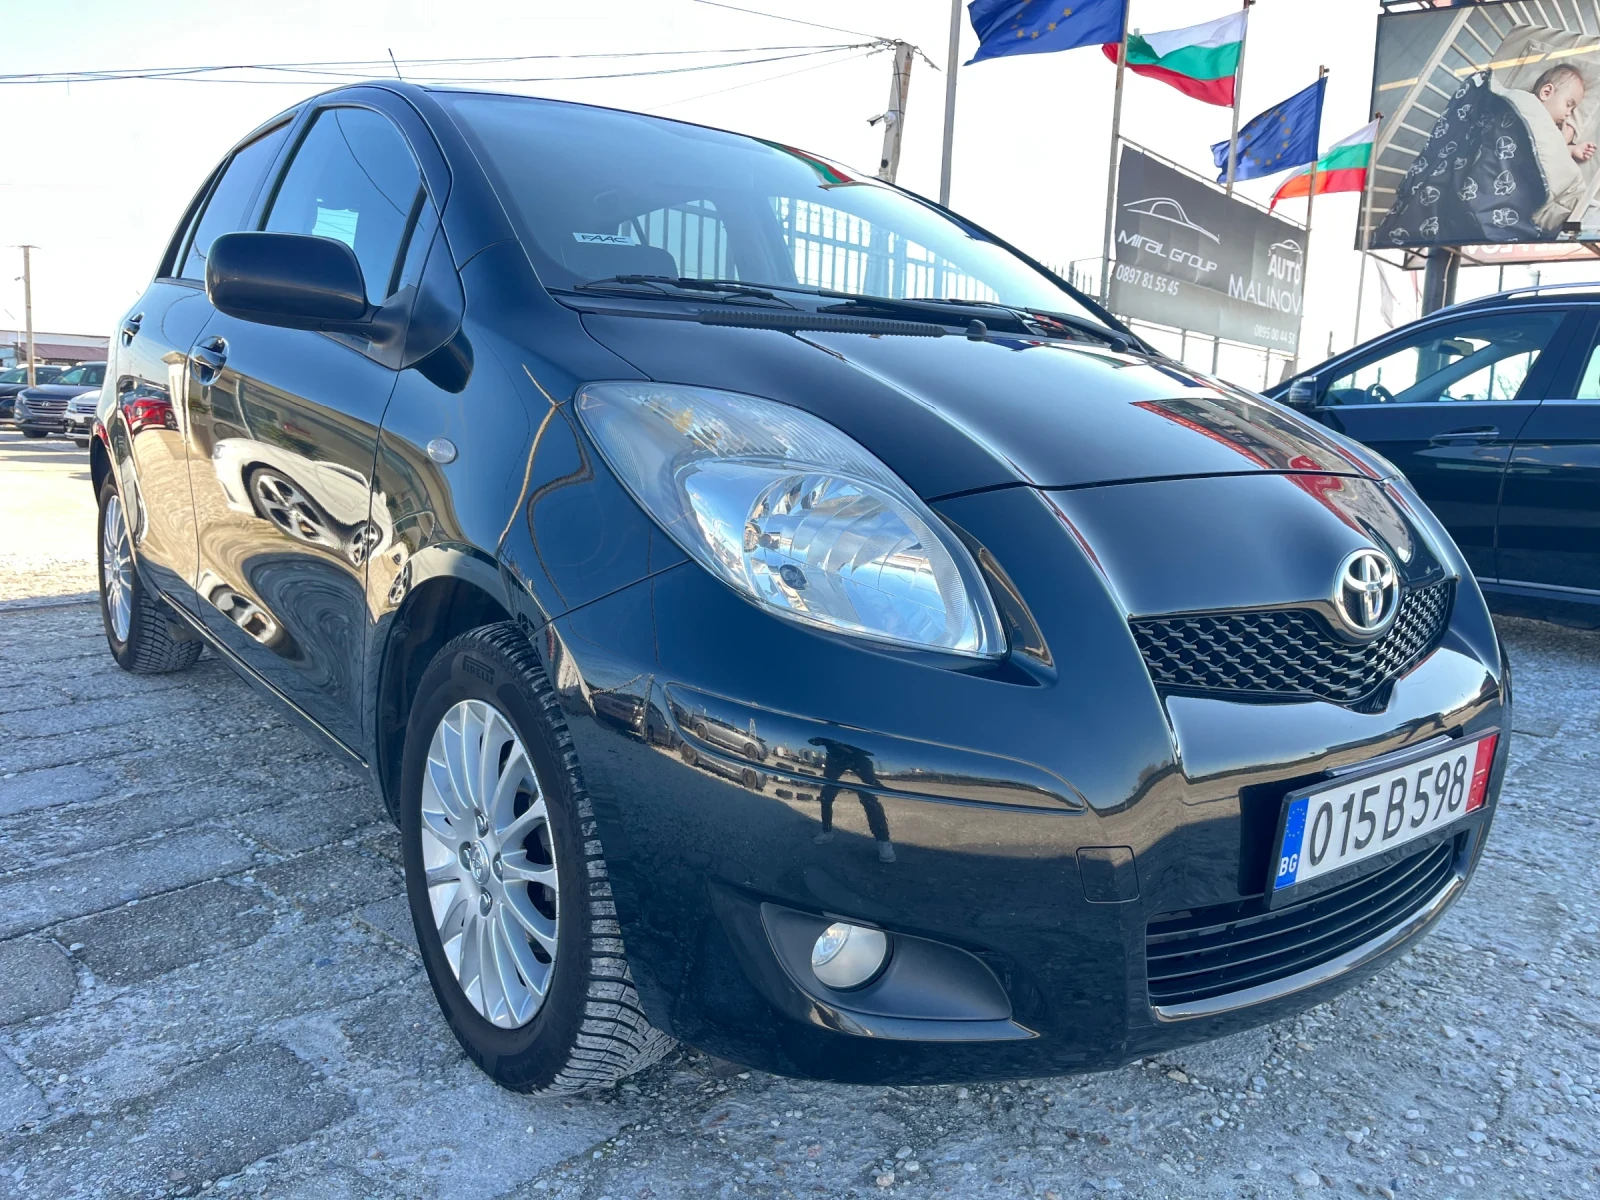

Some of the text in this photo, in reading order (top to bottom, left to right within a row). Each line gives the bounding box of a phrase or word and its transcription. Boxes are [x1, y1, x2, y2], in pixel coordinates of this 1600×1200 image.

[581, 234, 629, 244] FAAC
[1116, 264, 1180, 296] 0897 81 55 45
[1267, 254, 1301, 285] AUTO
[1228, 273, 1302, 315] MALINOV
[462, 654, 496, 686] PIRELLI
[1308, 755, 1468, 867] 015B598
[1277, 853, 1299, 877] BG
